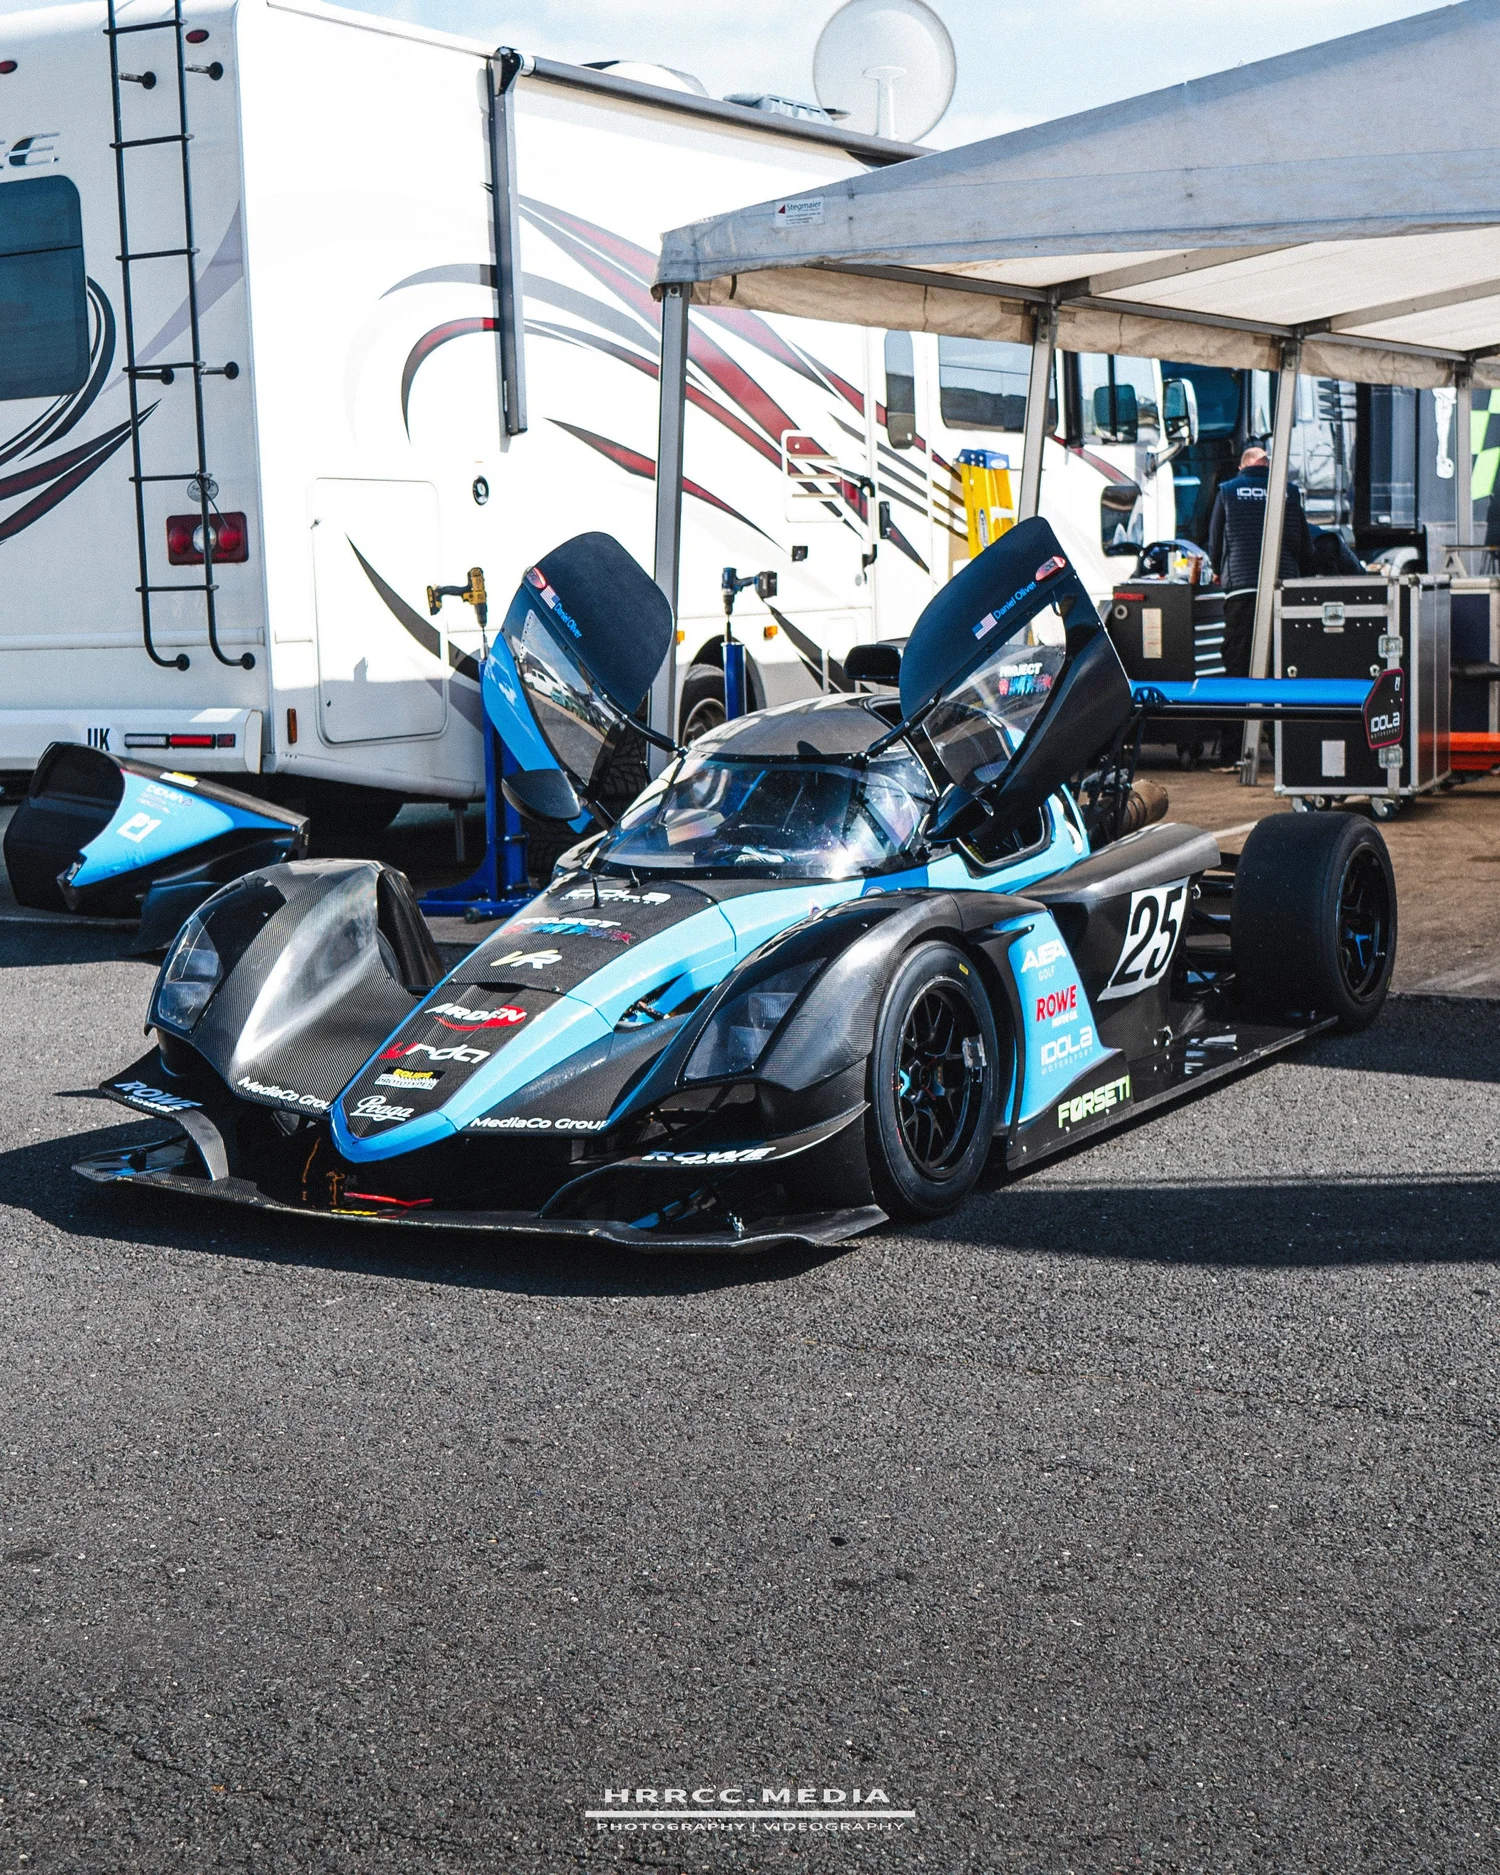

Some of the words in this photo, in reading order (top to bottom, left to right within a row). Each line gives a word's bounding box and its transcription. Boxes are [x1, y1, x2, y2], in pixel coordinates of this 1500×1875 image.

[786, 201, 822, 211] Stegmaier
[1236, 487, 1268, 498] IDOL
[993, 597, 1017, 620] Daniel
[1014, 581, 1037, 601] Oliver
[553, 602, 572, 623] Daniel
[566, 619, 583, 639] Oliver
[87, 728, 111, 751] UK
[1109, 883, 1184, 986] 25
[424, 1003, 527, 1023] ARDEN
[1036, 984, 1077, 1022] ROWE
[238, 1076, 300, 1101] MediaCo
[377, 1078, 434, 1088] PROTOTYPES
[350, 1095, 414, 1121] Praga
[470, 1116, 552, 1129] MediaCo
[642, 1147, 776, 1162] ROWE
